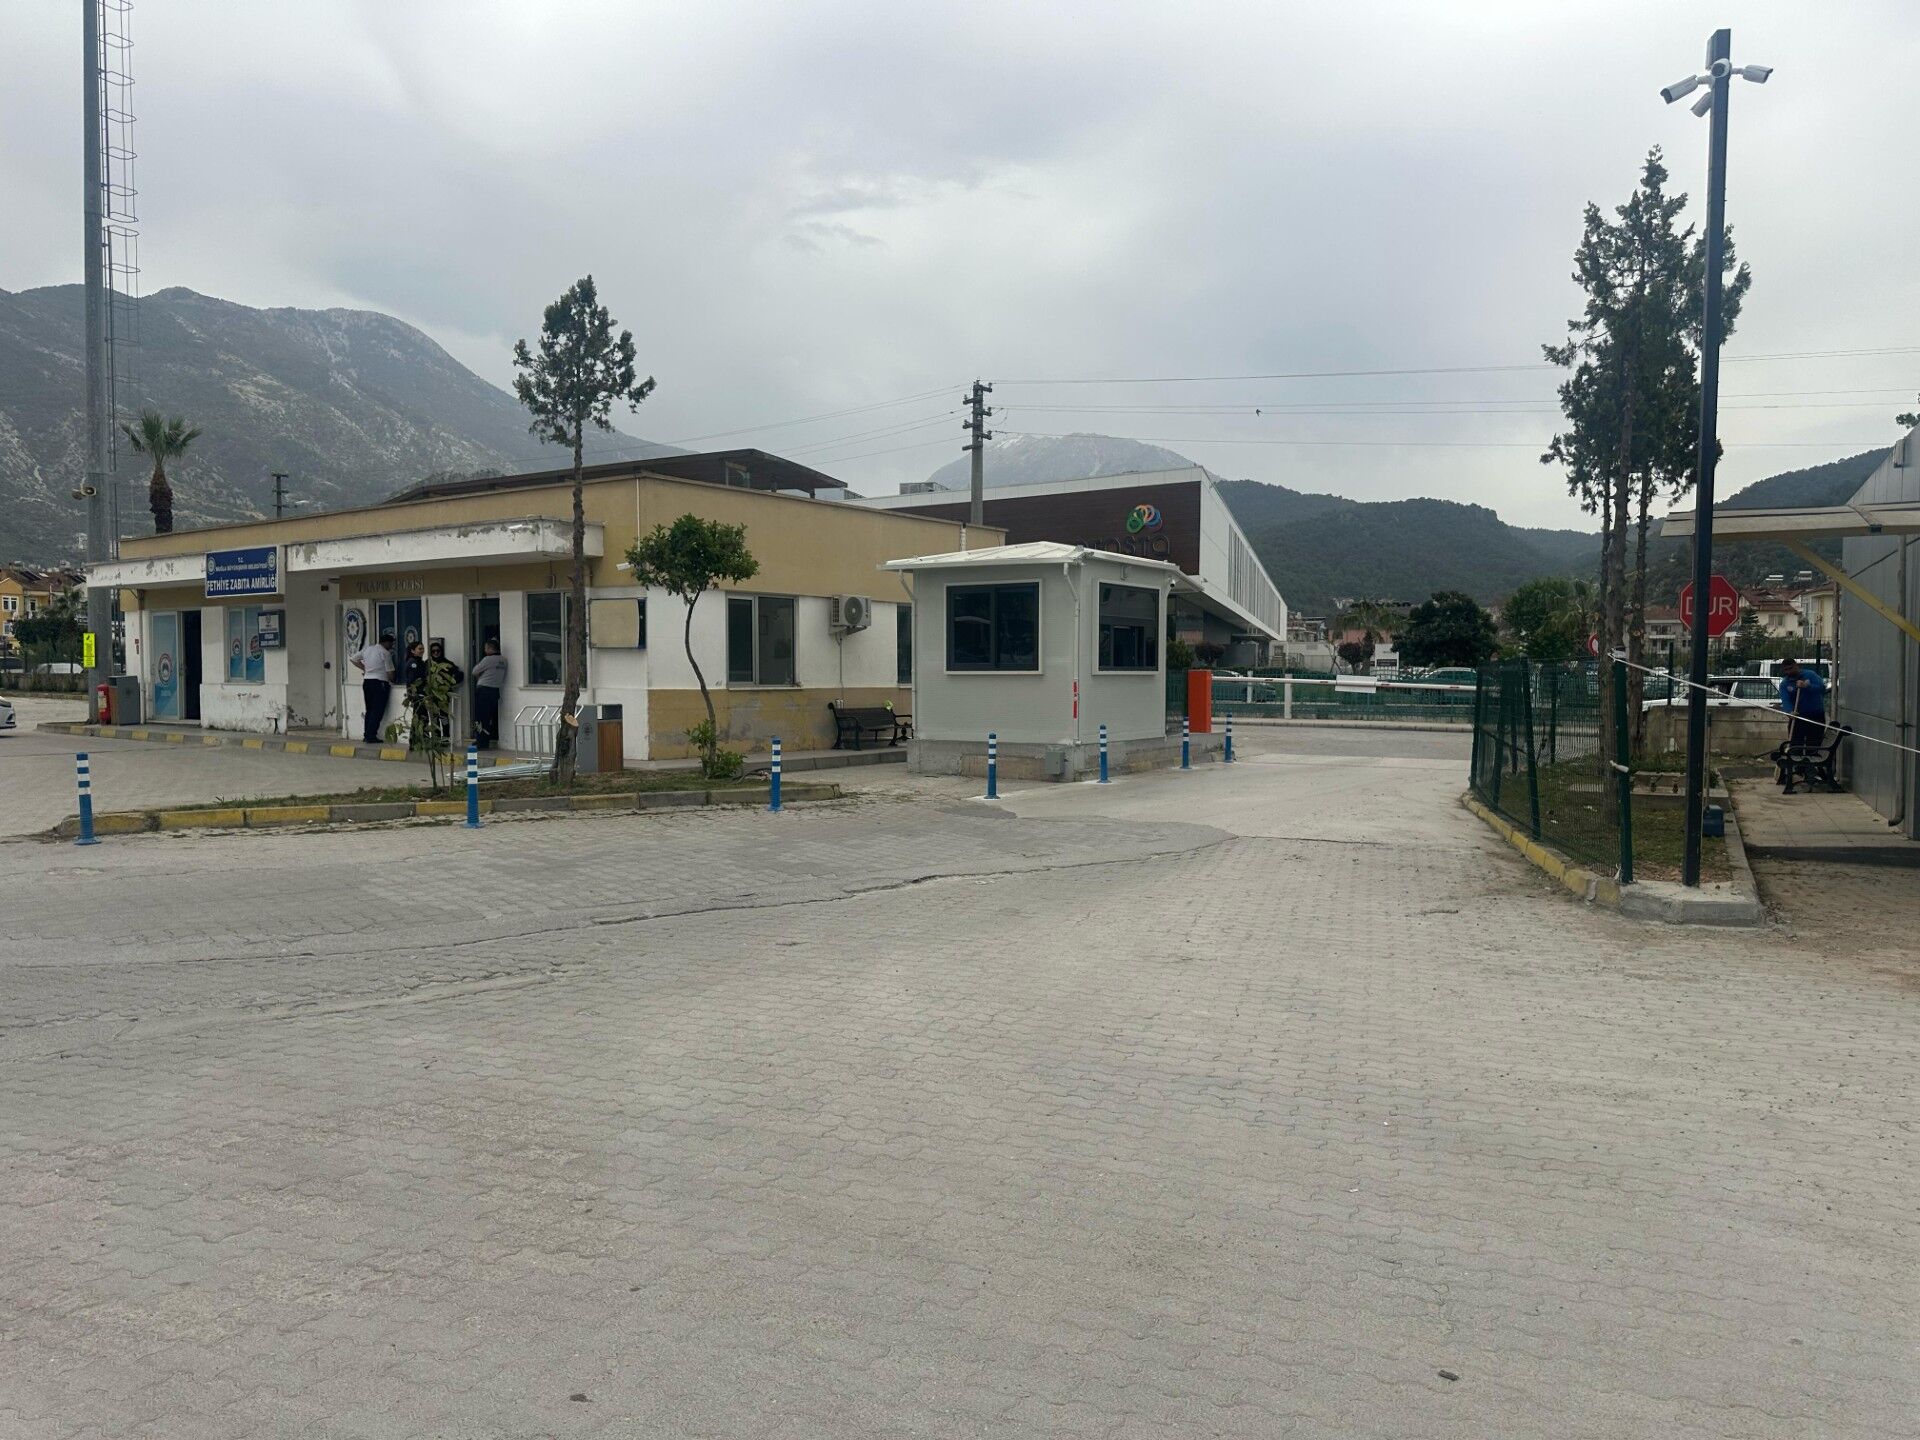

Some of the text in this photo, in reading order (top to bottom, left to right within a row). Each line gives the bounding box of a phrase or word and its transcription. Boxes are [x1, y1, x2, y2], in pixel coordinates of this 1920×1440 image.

[206, 573, 278, 592] FETHİYE ZABITA AMİRLİĞİ
